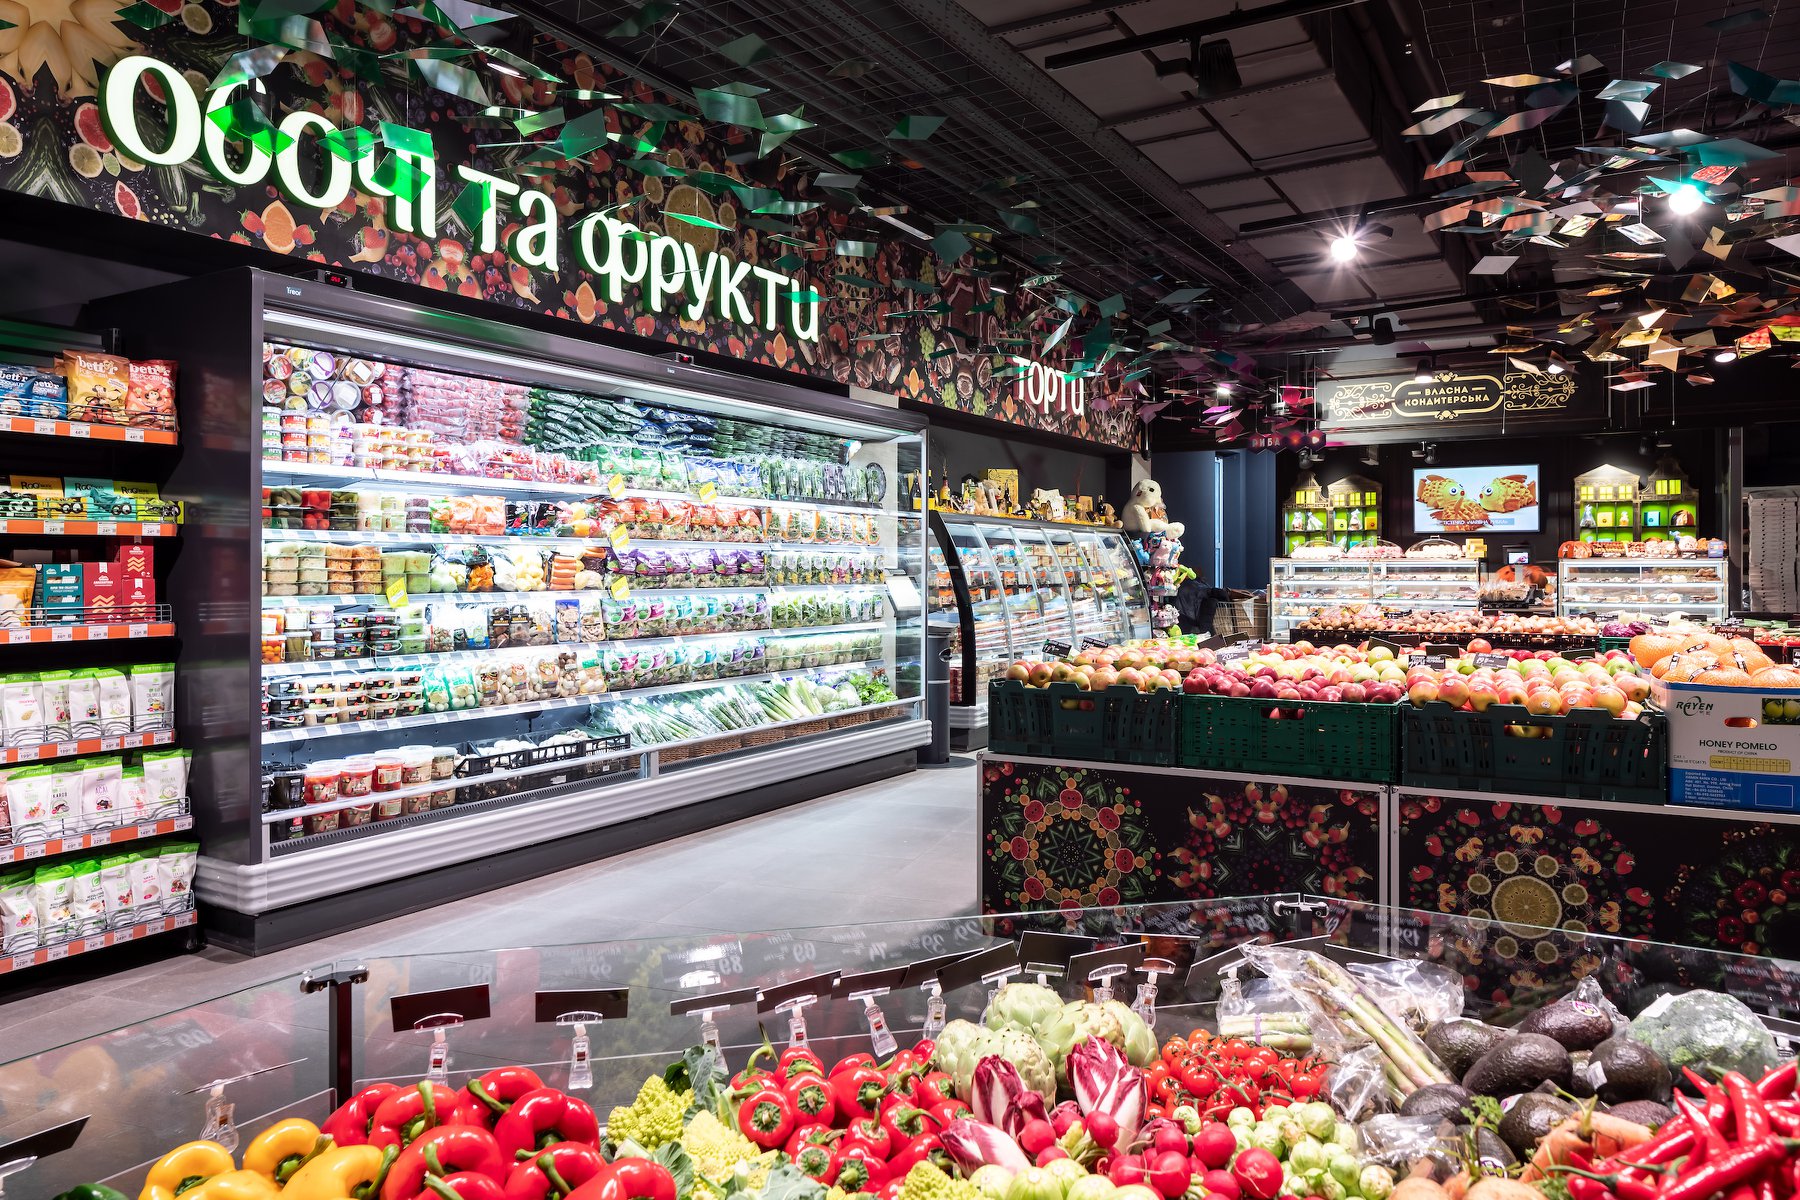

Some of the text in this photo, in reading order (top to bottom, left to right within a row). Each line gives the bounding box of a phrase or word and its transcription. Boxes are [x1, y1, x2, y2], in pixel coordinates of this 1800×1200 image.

[1425, 385, 1469, 396] ВЛАСНА
[1404, 393, 1490, 407] КОНДИТЕРСЬКА
[1699, 739, 1778, 751] HONEY POMELO
